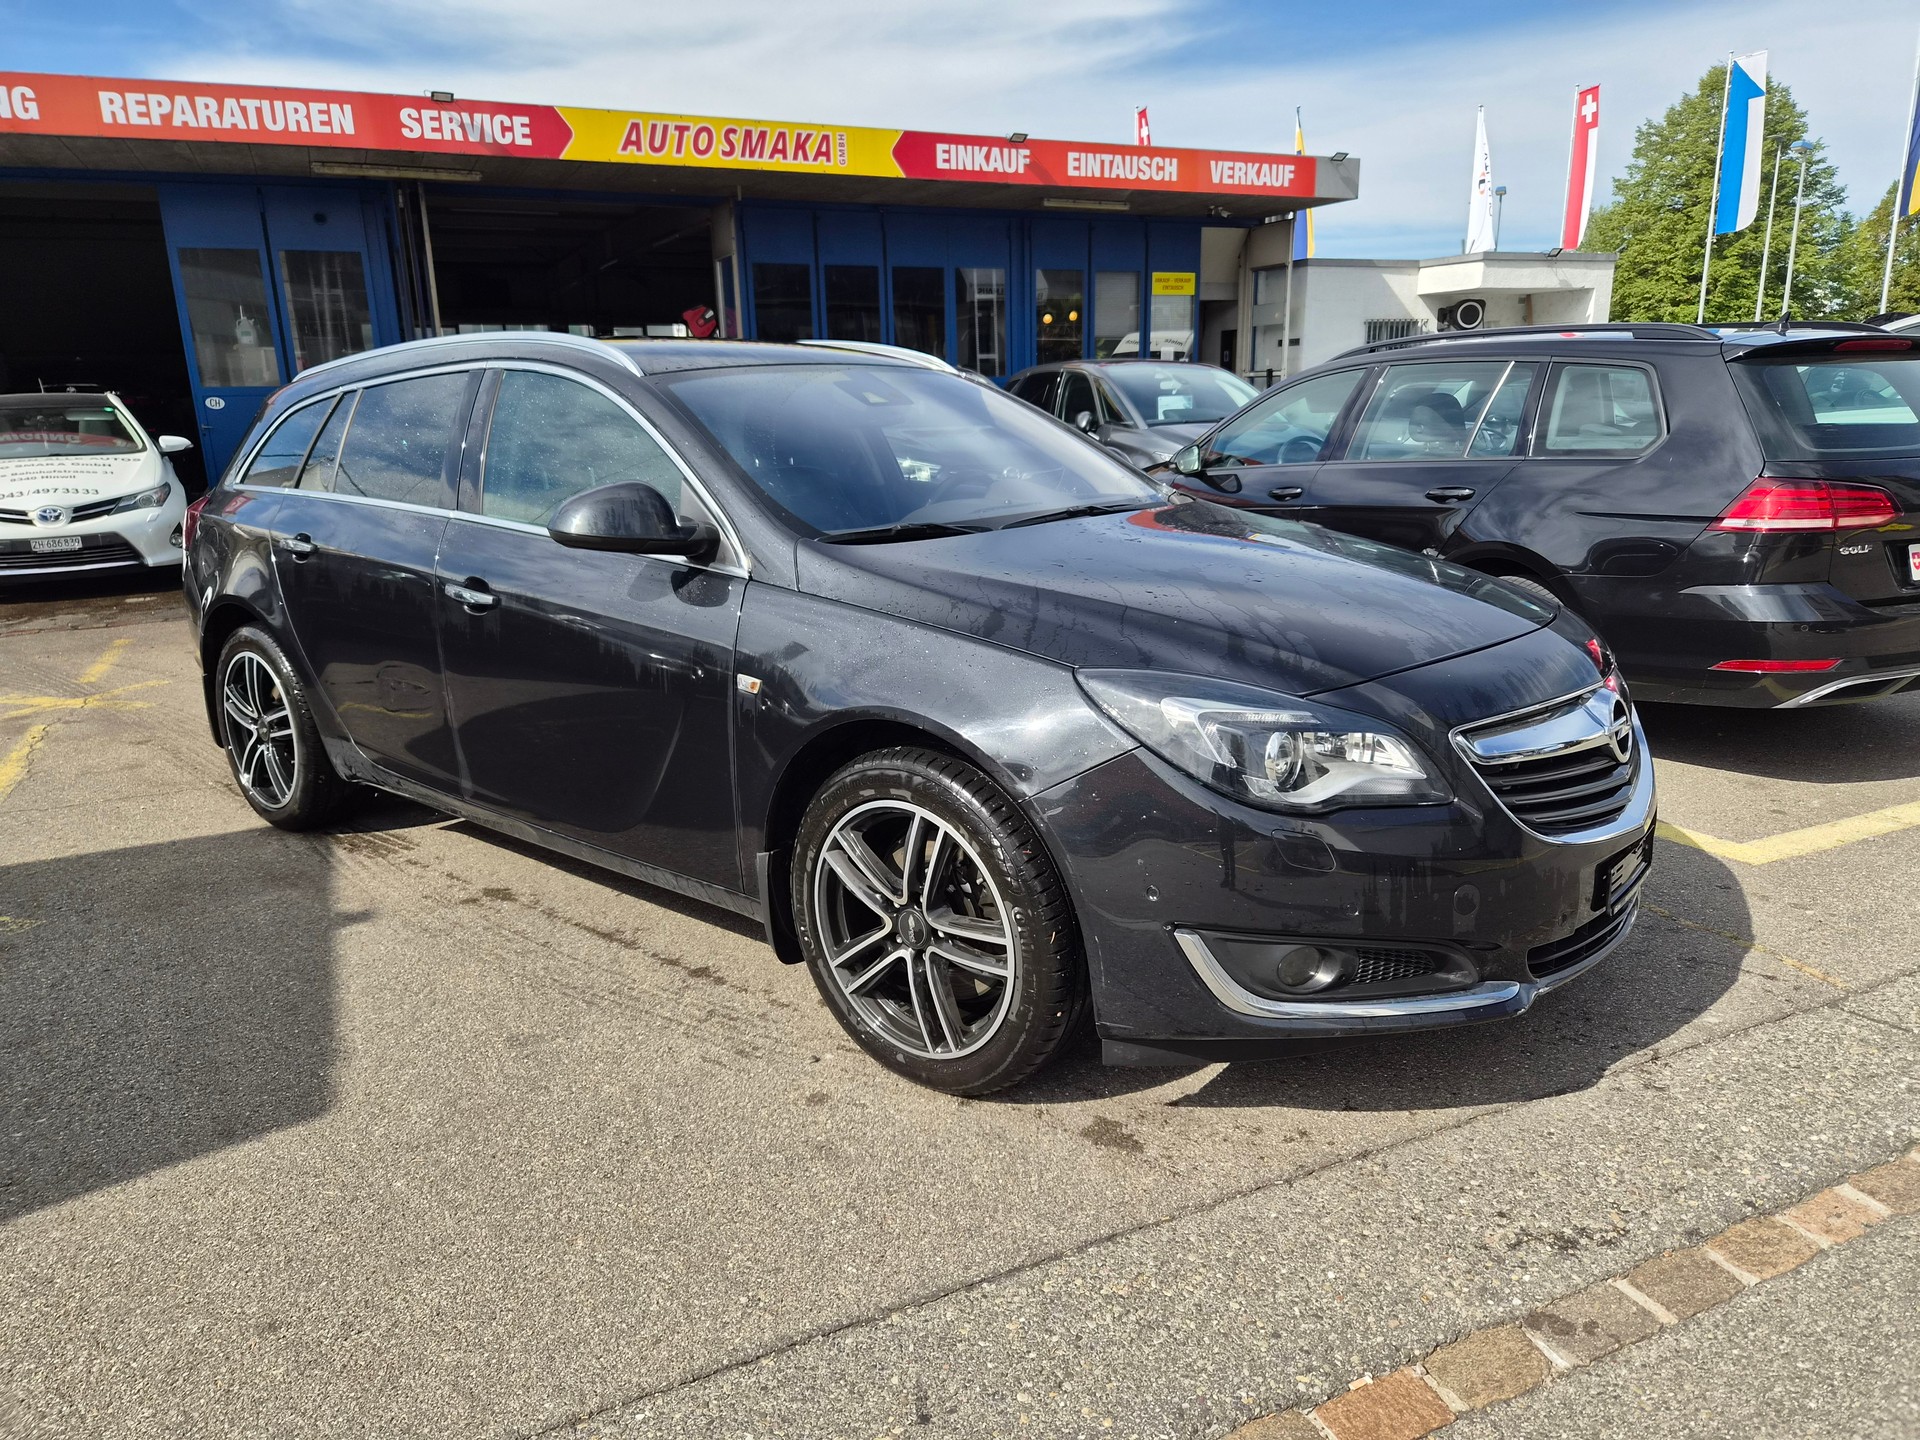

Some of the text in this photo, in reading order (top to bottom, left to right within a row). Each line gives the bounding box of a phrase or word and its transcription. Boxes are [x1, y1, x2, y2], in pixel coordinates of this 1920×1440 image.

[98, 91, 355, 135] REPARATUREN
[400, 108, 532, 145] SERVICE
[620, 121, 833, 164] AUTO SMAKA
[838, 132, 846, 166] GMBH
[936, 144, 1295, 187] EINKAUF EINTAUSCH VERKAUF
[209, 398, 221, 407] CH
[1839, 544, 1873, 555] GOLF
